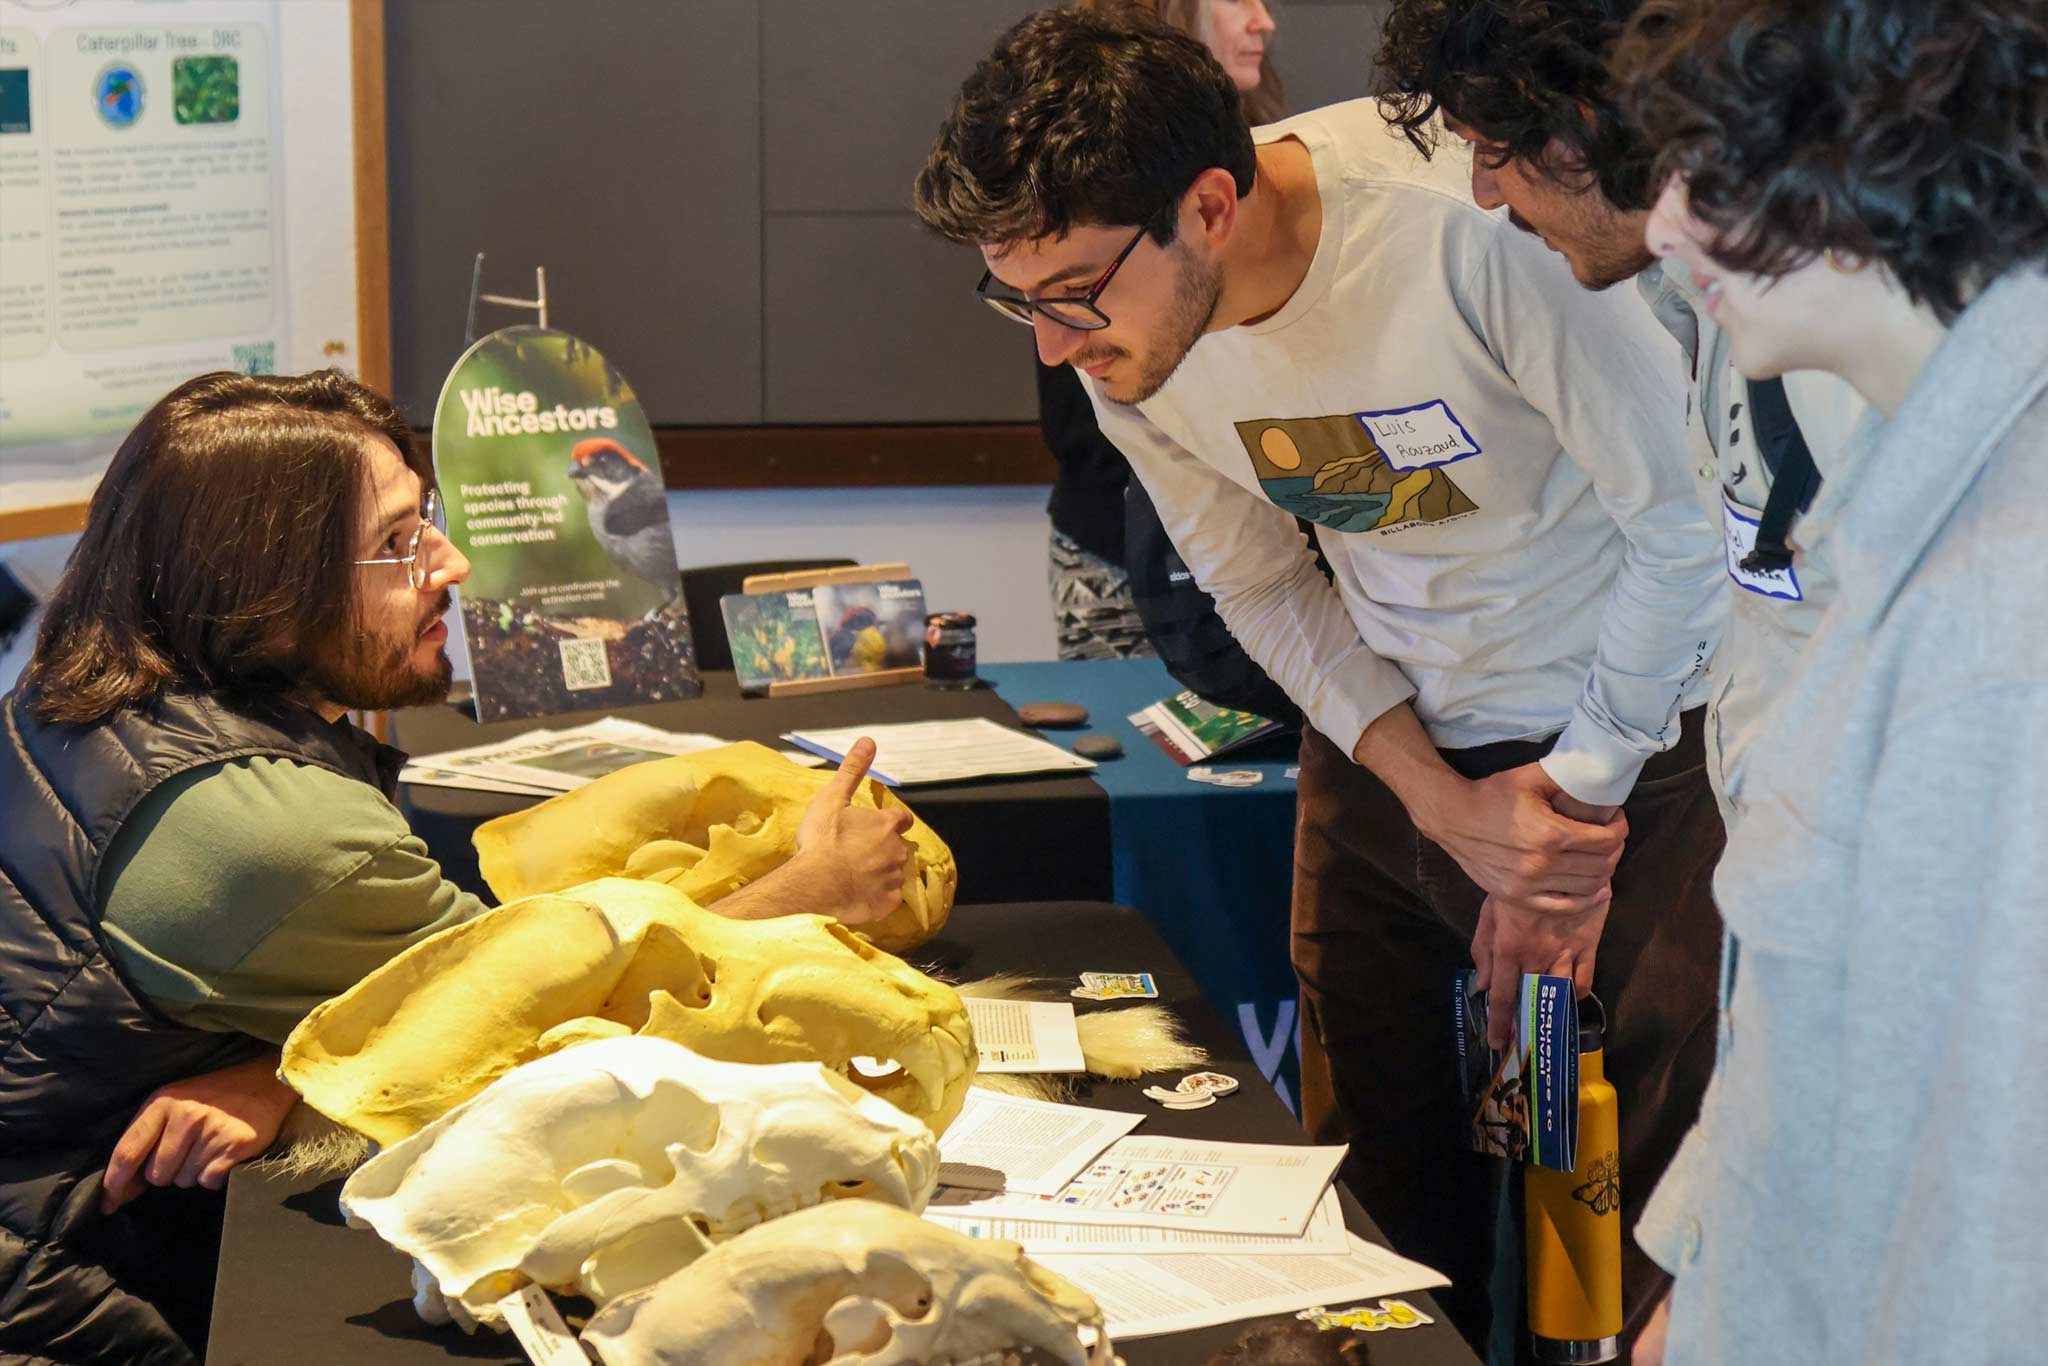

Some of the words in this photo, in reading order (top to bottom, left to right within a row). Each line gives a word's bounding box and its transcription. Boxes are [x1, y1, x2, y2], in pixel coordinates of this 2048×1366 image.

[76, 33, 159, 52] Caterpillar
[166, 31, 197, 48] Tree
[460, 386, 537, 416] Wise
[467, 404, 618, 437] Ancestors
[460, 481, 530, 497] Protecting
[464, 499, 515, 516] species
[516, 494, 567, 510] through
[467, 511, 563, 530] community-led
[469, 529, 555, 546] conservation
[1540, 985, 1549, 1075] Survival
[1547, 985, 1557, 1102] Sequence
[1546, 1109, 1553, 1132] to
